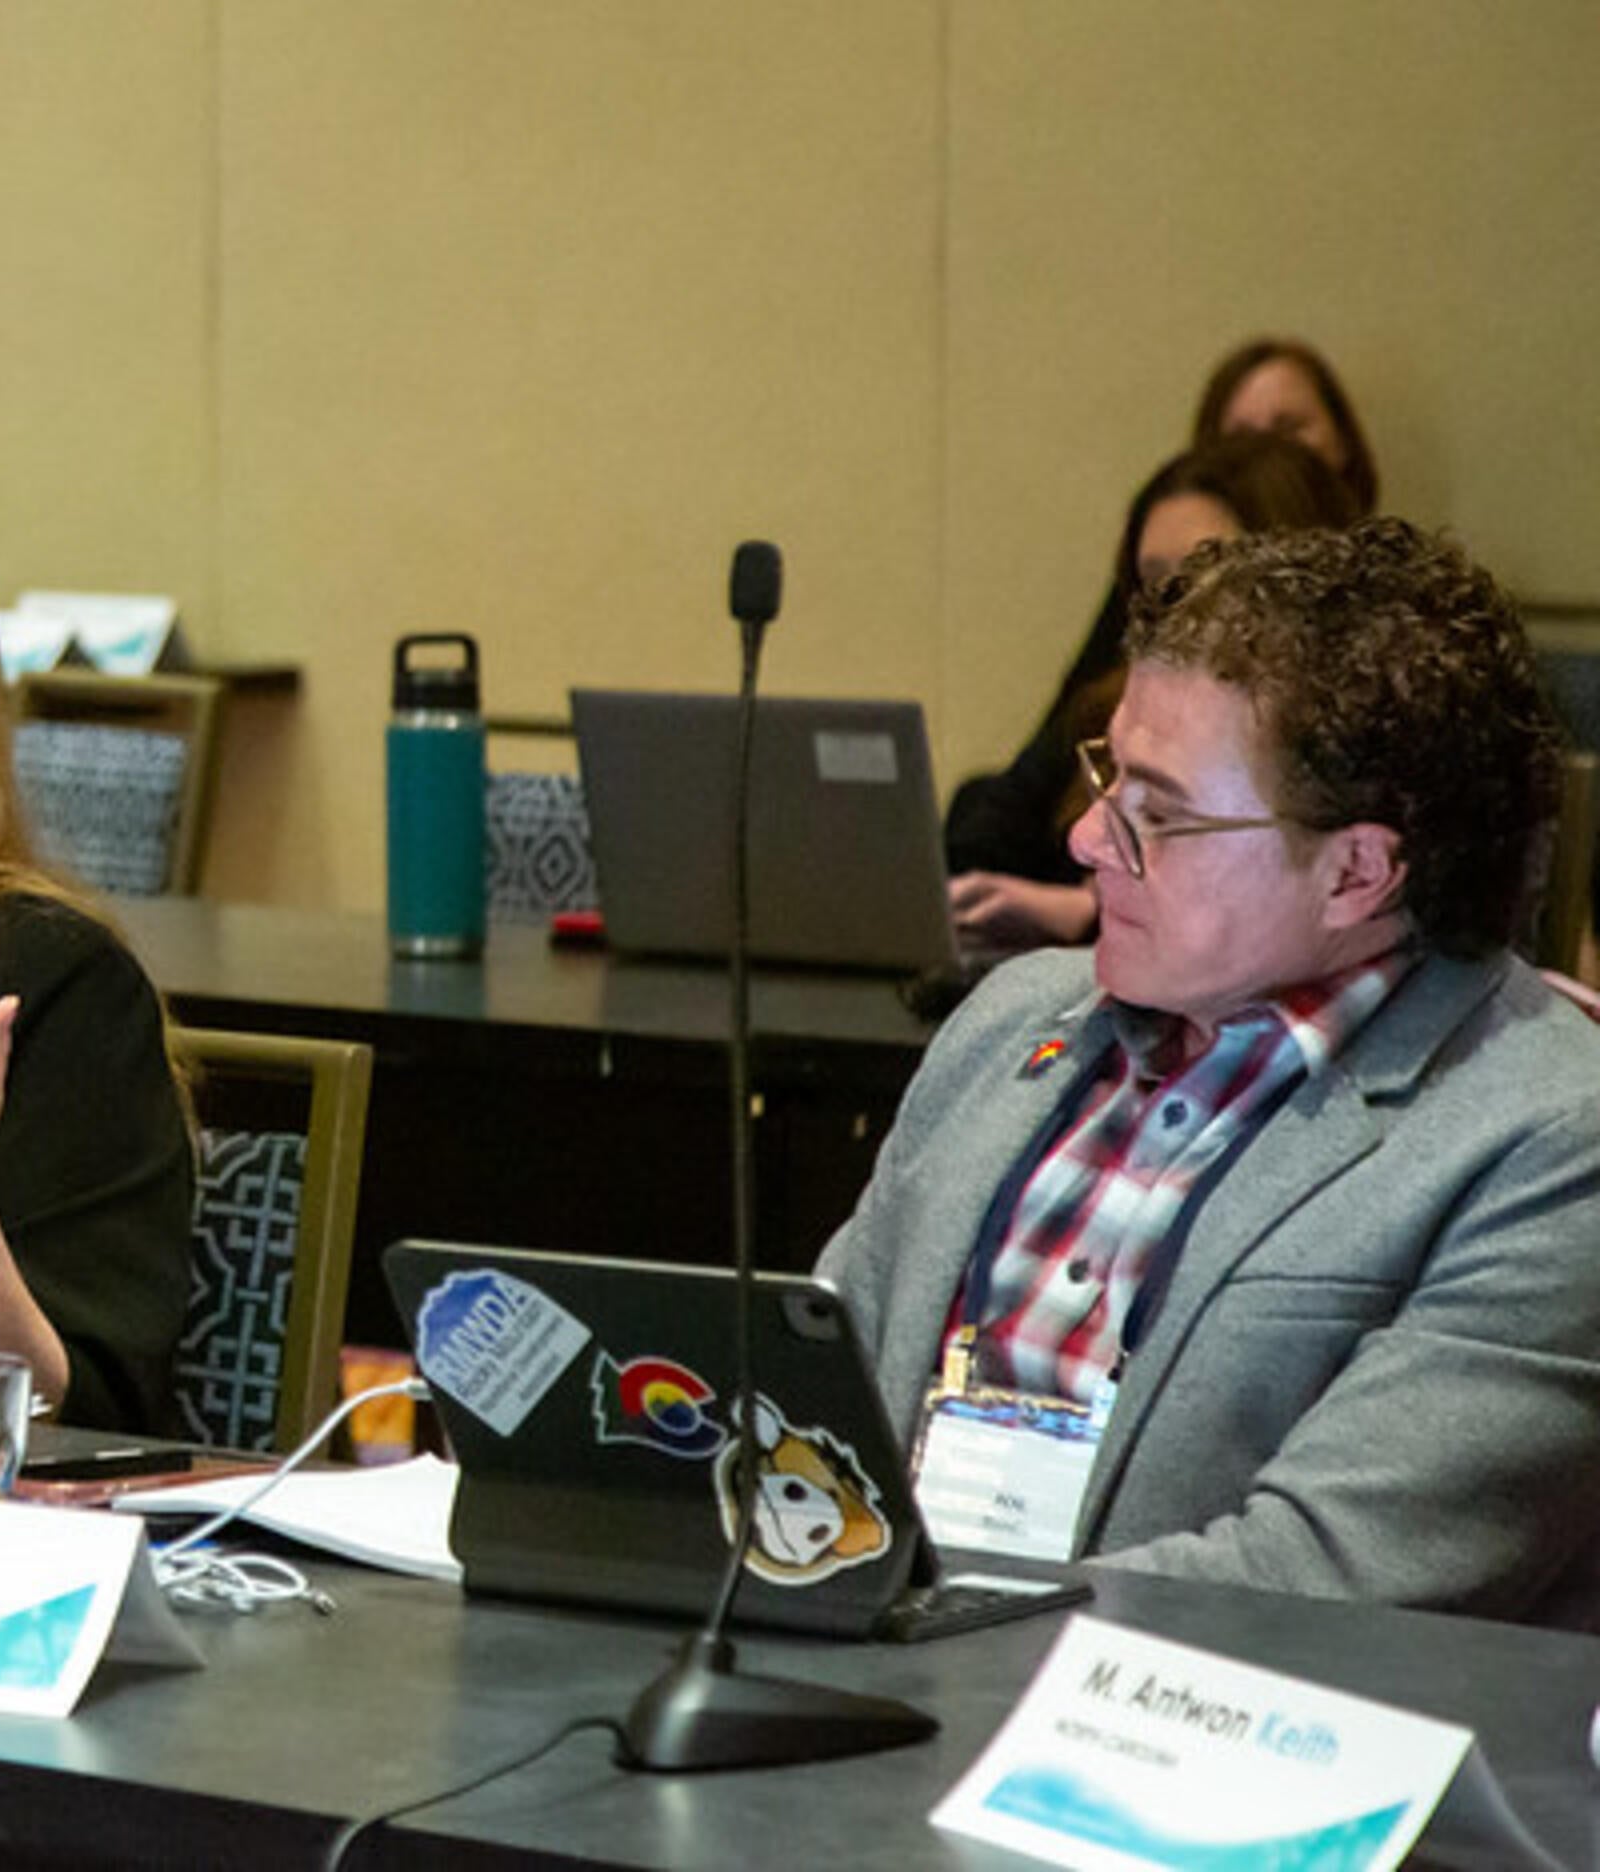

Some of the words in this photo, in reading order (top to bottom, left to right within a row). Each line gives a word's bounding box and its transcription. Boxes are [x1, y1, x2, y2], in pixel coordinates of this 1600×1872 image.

[1082, 1659, 1120, 1699] M.
[1129, 1674, 1252, 1740] Antwon
[1256, 1710, 1341, 1765] Keith
